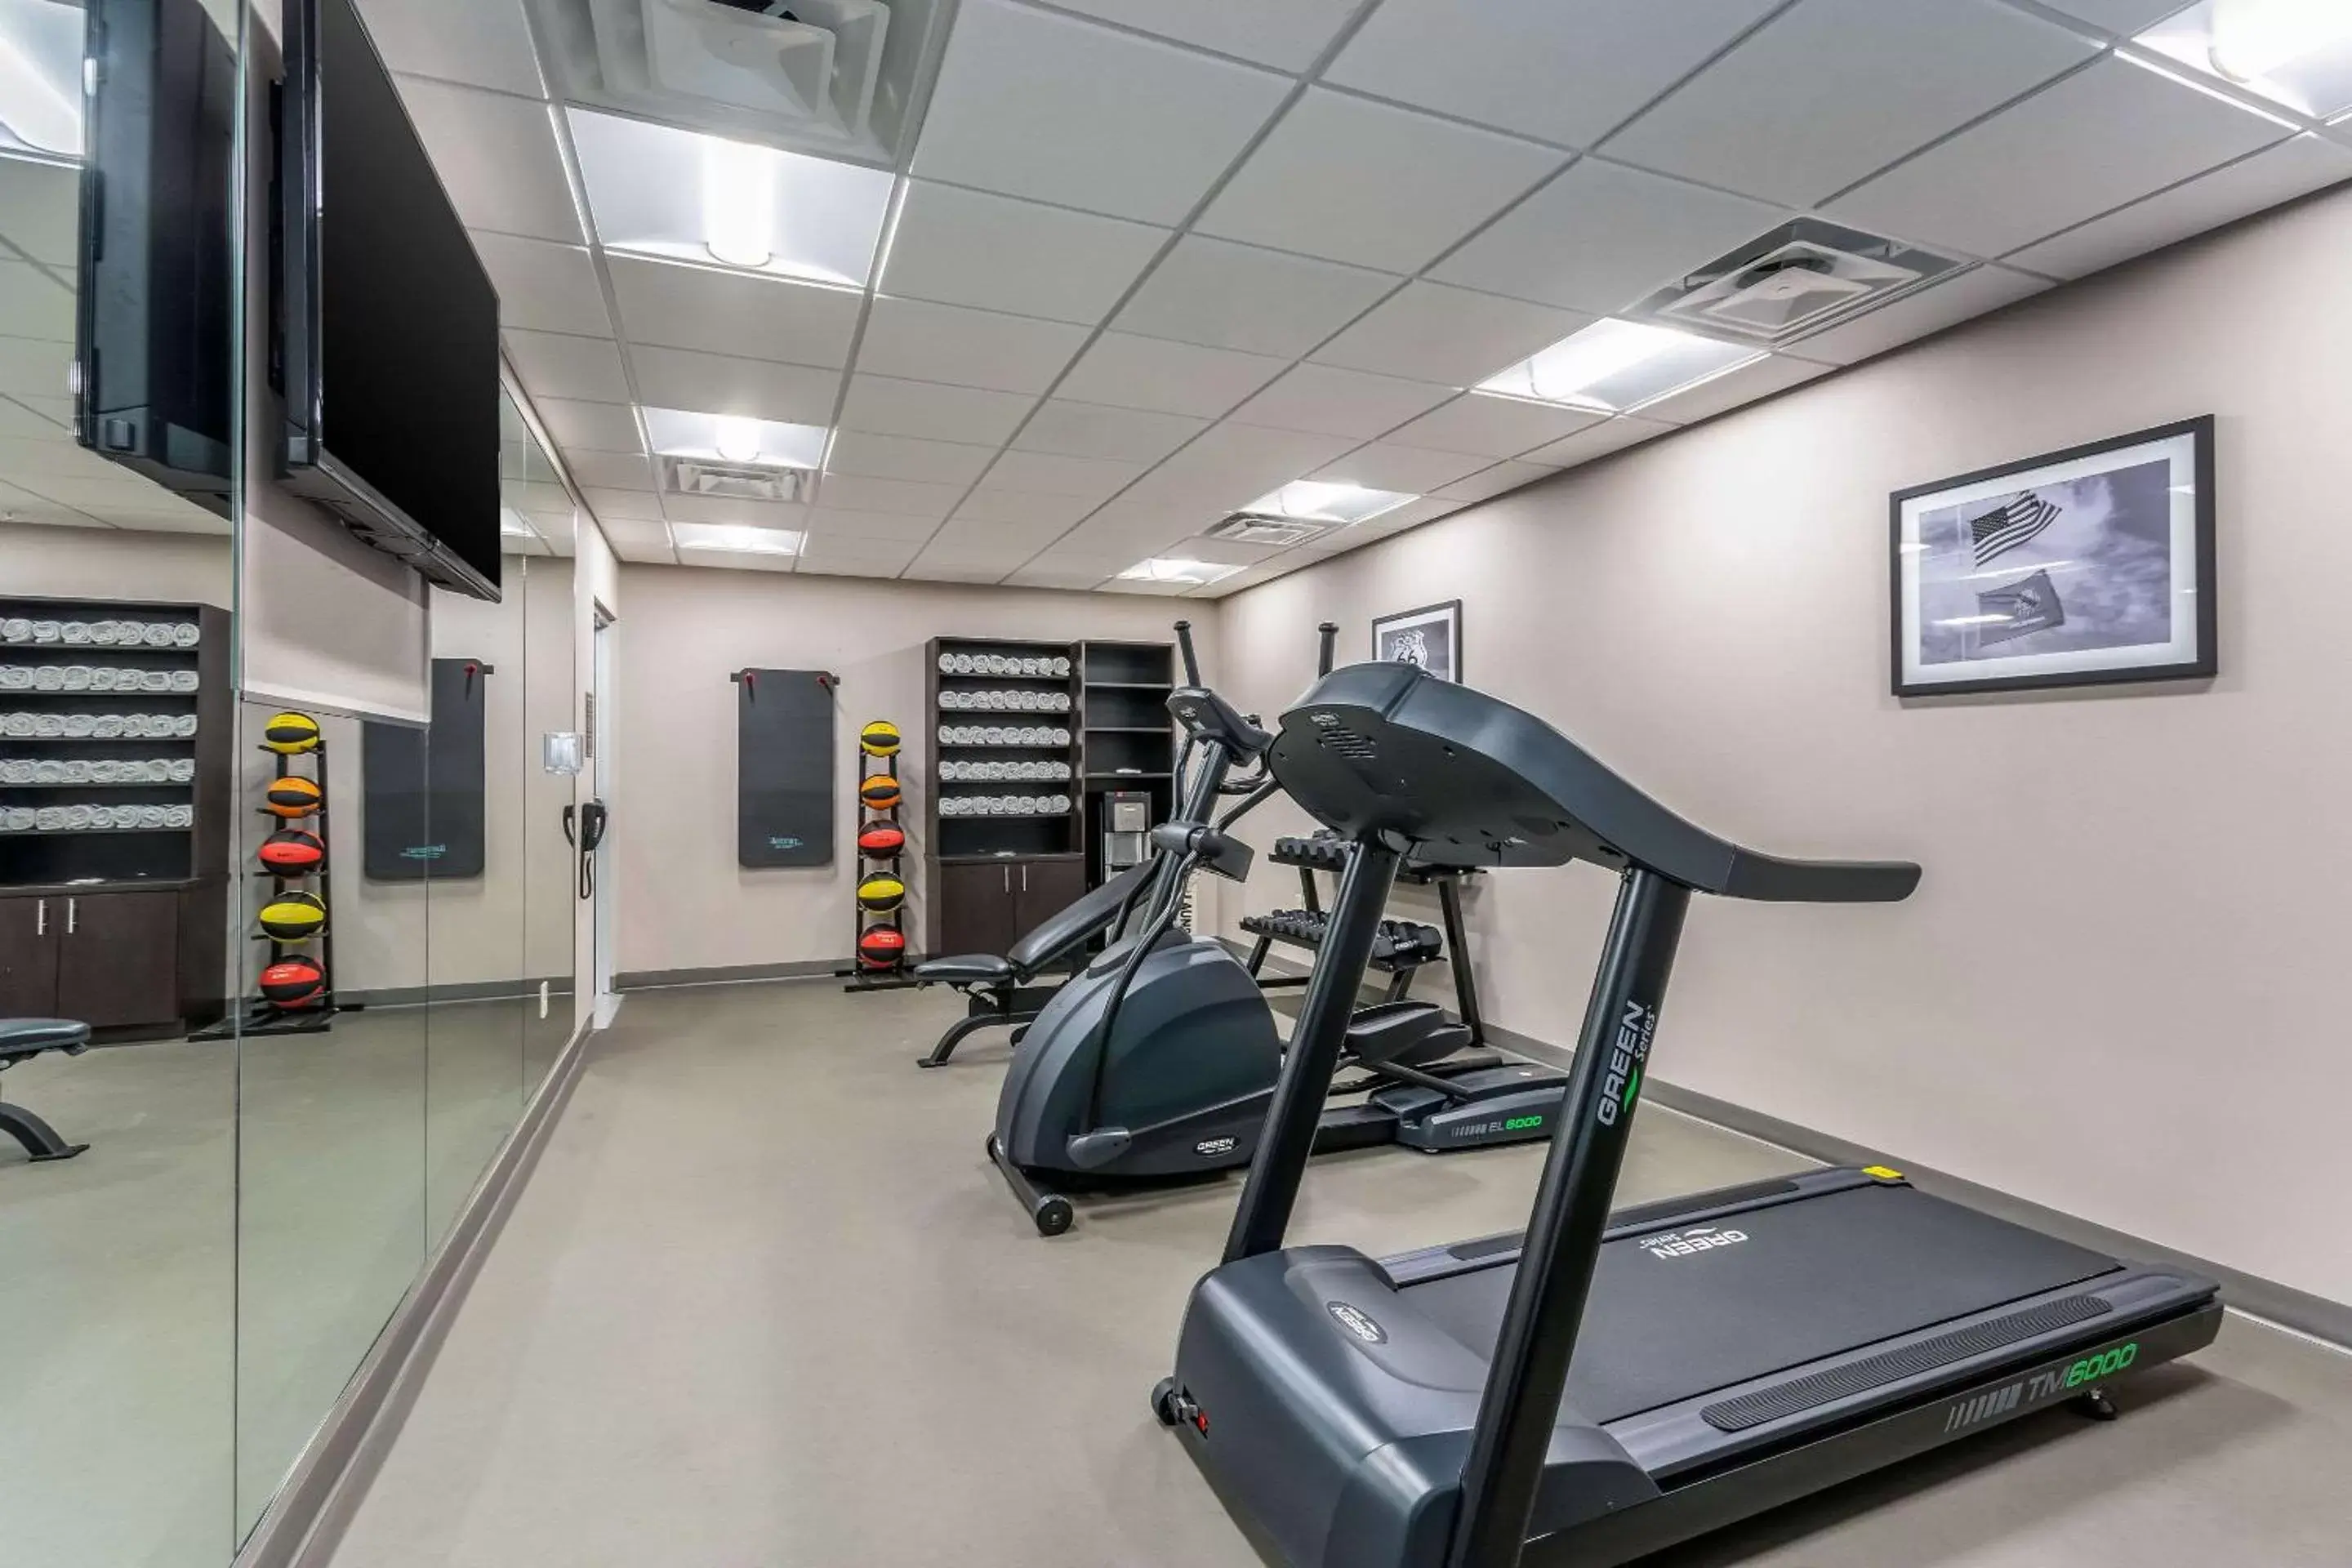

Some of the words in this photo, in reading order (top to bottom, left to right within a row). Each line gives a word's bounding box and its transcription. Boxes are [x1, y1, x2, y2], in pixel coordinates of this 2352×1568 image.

[1597, 1000, 1644, 1126] GREEN
[1197, 1137, 1235, 1150] GREEN
[1650, 1230, 1748, 1260] GREEN
